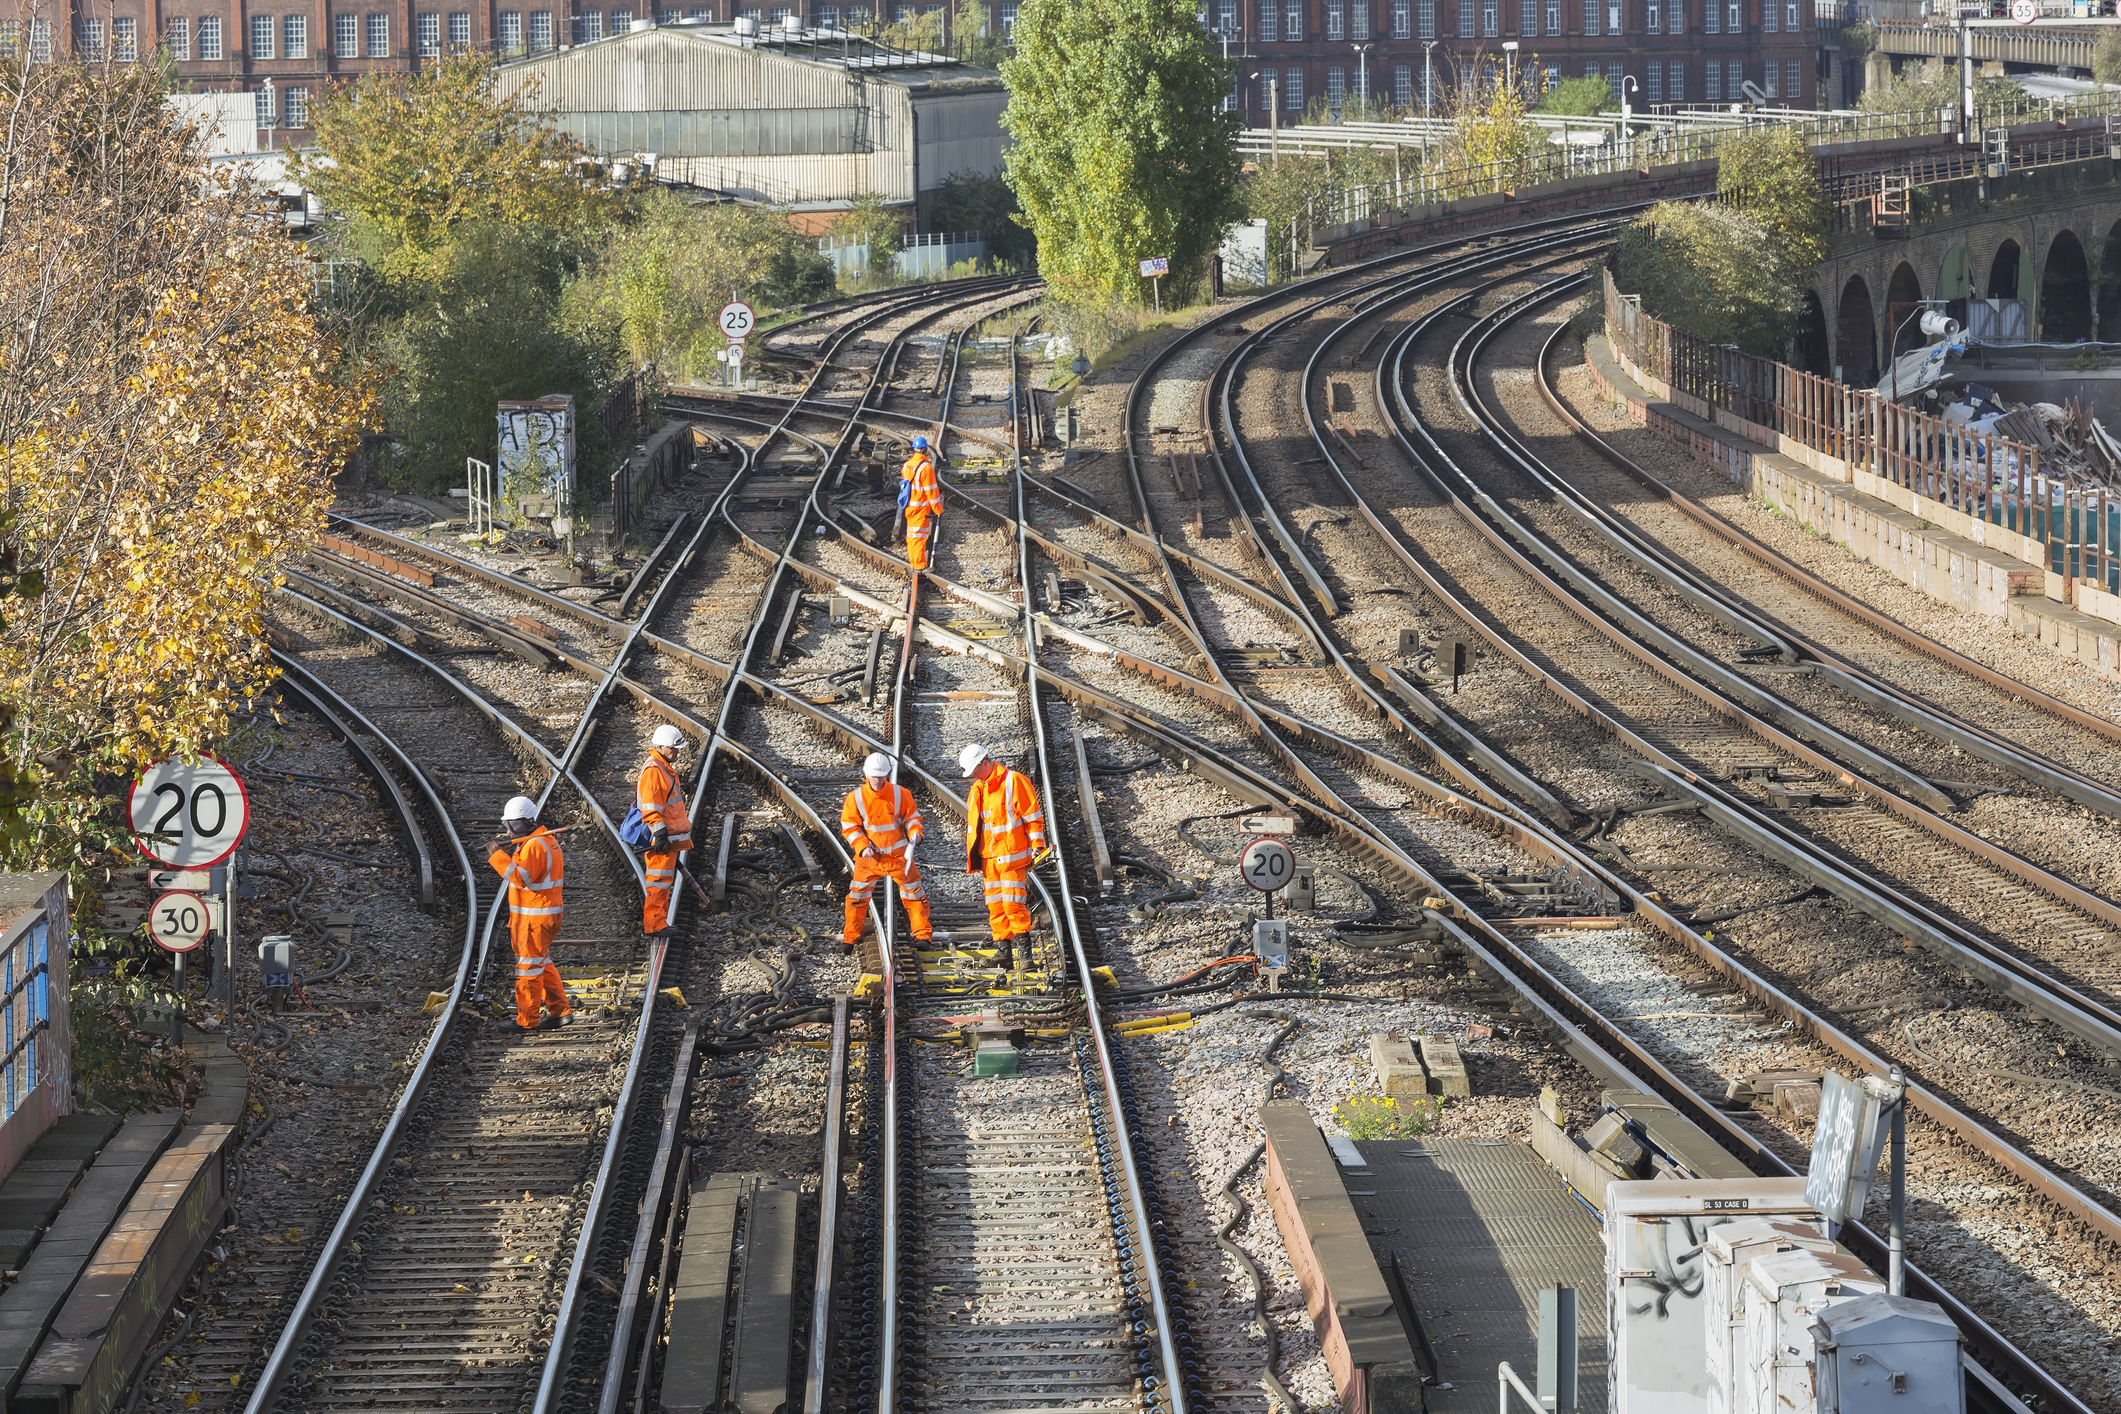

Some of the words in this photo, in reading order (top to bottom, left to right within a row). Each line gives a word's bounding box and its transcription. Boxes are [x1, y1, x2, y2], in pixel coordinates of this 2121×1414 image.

[2016, 5, 2032, 17] 35
[726, 311, 748, 329] 25
[731, 349, 740, 357] 15
[153, 782, 227, 838] 20
[1252, 853, 1285, 877] 20
[161, 907, 199, 936] 30
[1704, 1201, 1712, 1209] SL
[1714, 1201, 1722, 1209] 53
[1724, 1200, 1740, 1208] CASE
[1742, 1200, 1748, 1208] D
